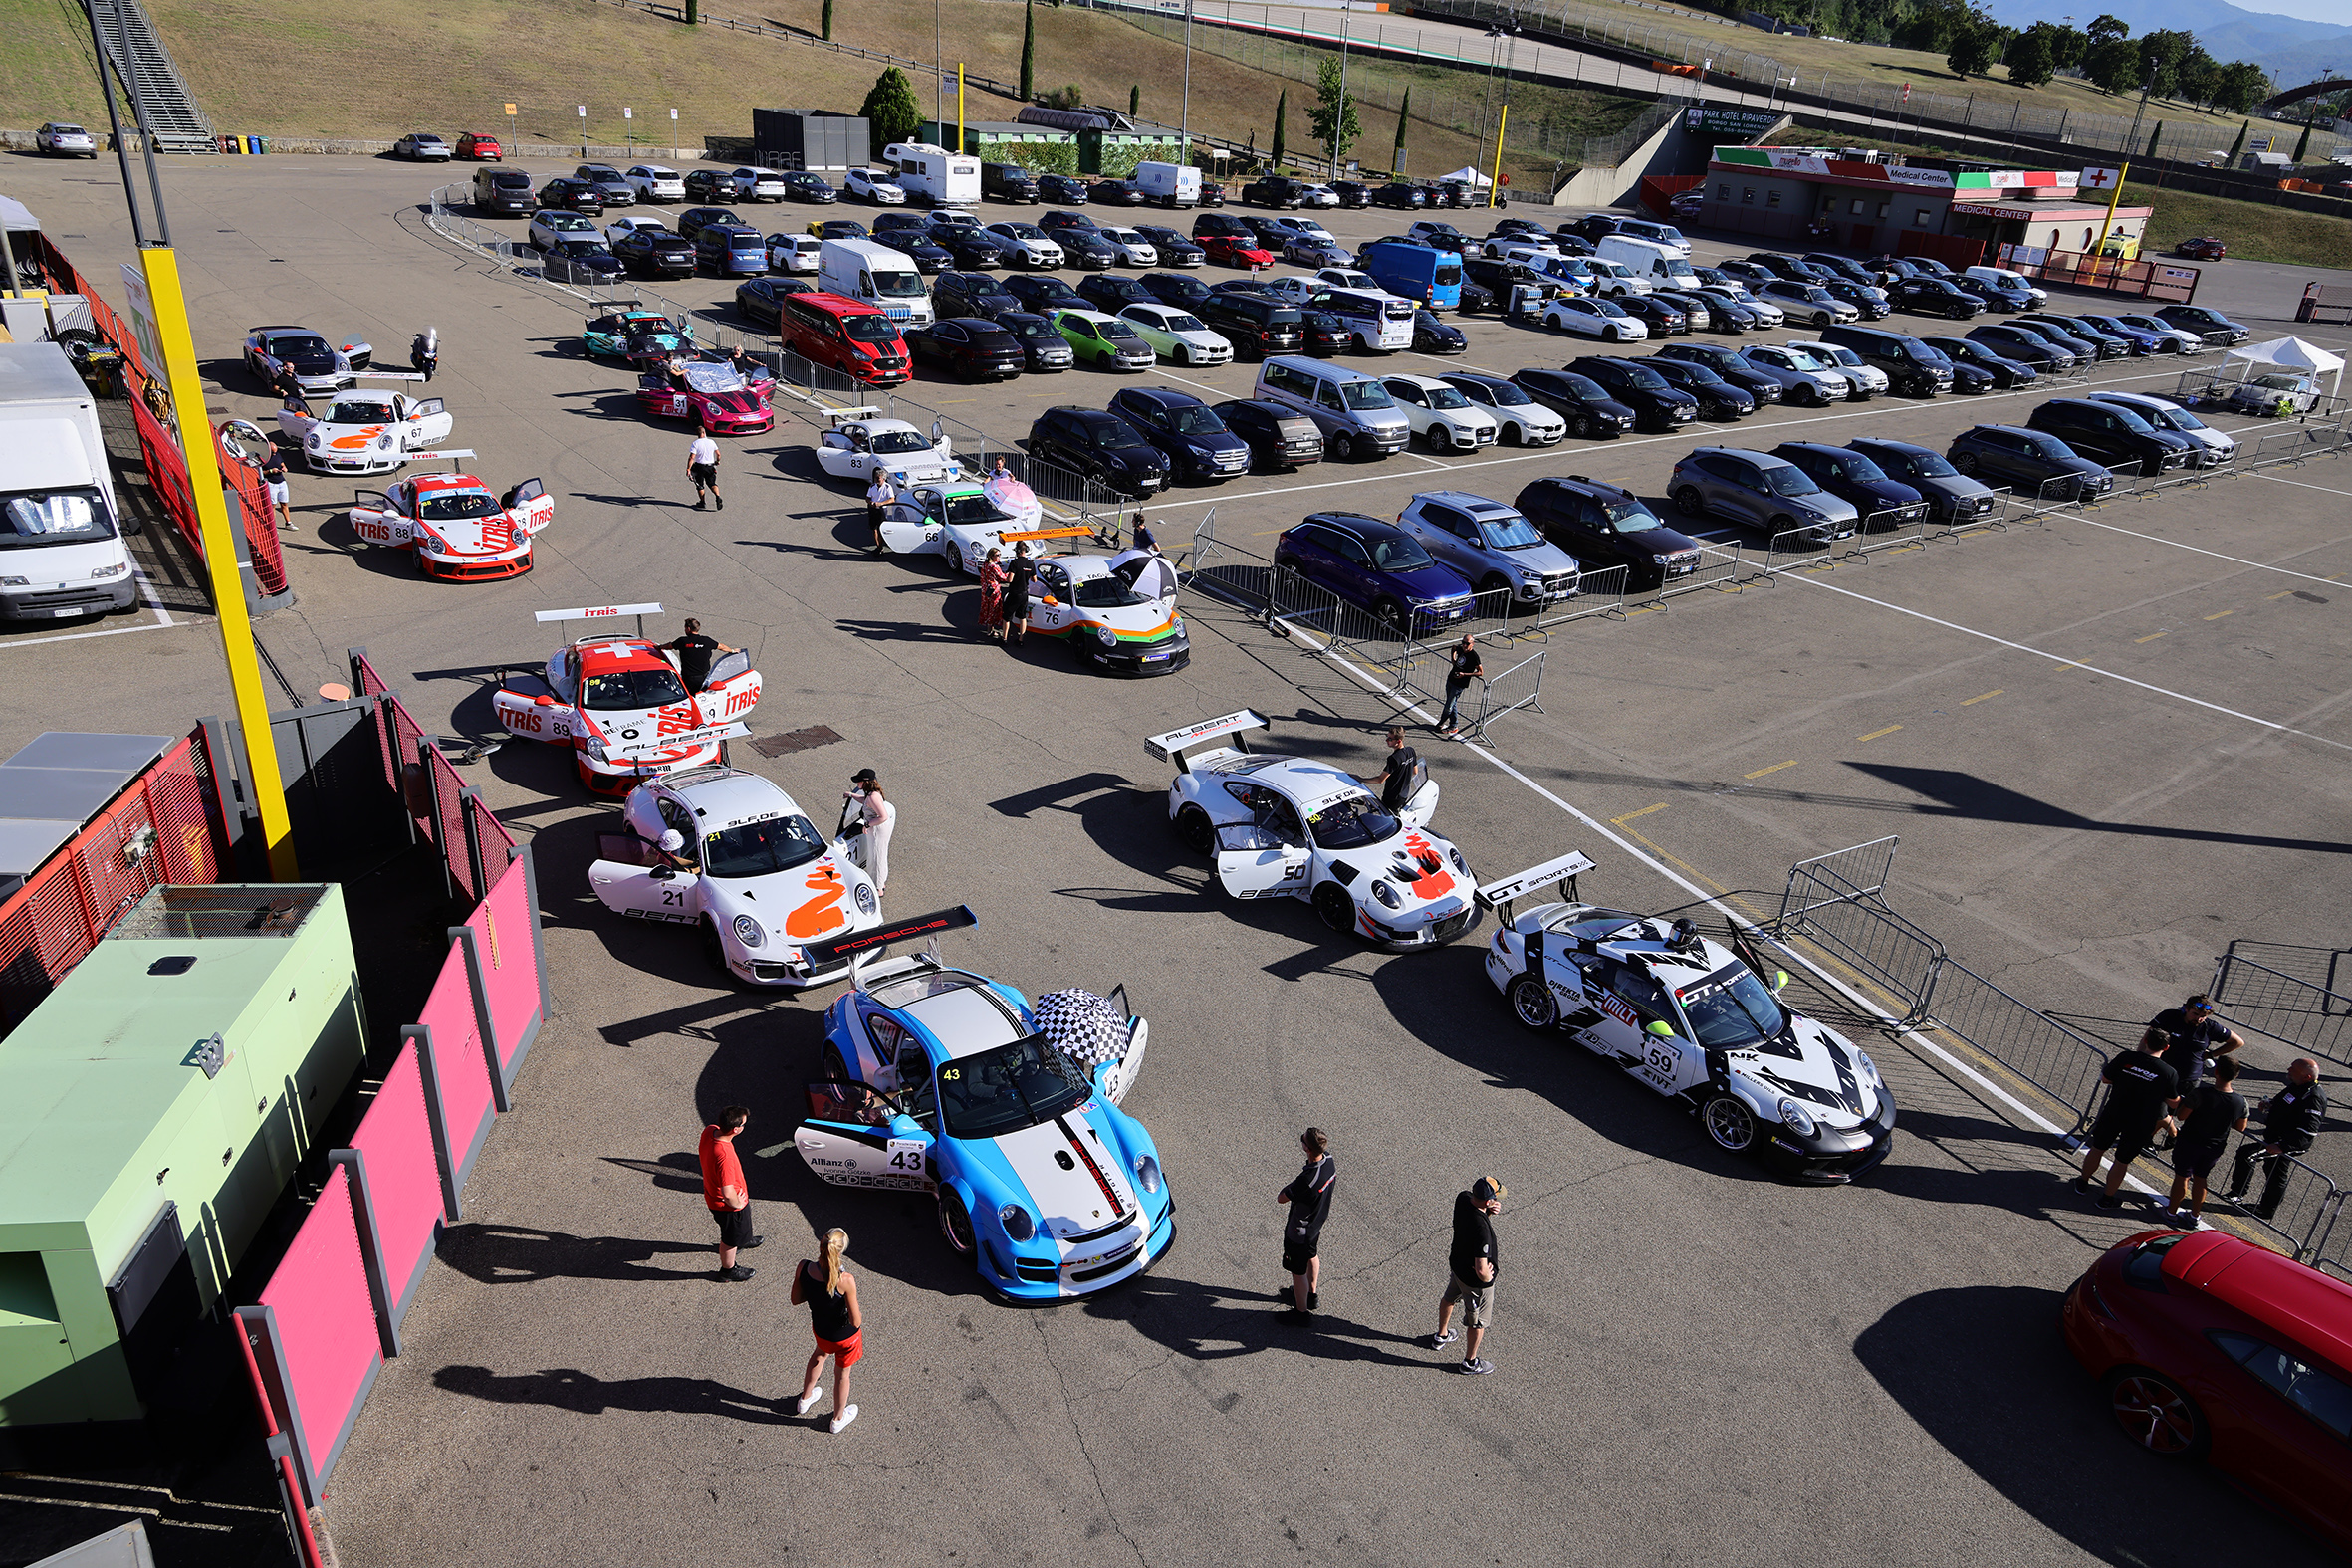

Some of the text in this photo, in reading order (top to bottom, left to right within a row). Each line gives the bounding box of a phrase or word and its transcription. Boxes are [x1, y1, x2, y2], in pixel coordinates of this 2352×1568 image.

[1703, 110, 1776, 124] PARK HOTEL RIPAVERDE
[1890, 169, 1949, 183] Medical Center
[1953, 204, 2030, 221] MEDICAL CENTER
[675, 398, 686, 408] 31
[411, 428, 422, 438] 67
[850, 459, 863, 469] 83
[430, 487, 471, 497] ROSCAR
[395, 526, 409, 540] 88
[925, 532, 939, 543] 66
[1006, 527, 1085, 539] PORSCHE
[1045, 611, 1059, 625] 76
[552, 722, 570, 737] 89
[602, 718, 647, 736] REFRAME
[1165, 715, 1240, 743] ALBERT
[1190, 719, 1243, 739] Motorsport
[622, 727, 731, 753] ALBERT
[651, 731, 730, 752] Motorsport
[1308, 813, 1321, 825] 50
[707, 831, 722, 842] 21
[1283, 865, 1306, 882] 50
[1487, 863, 1579, 902] GT SPORTS
[662, 890, 684, 907] 21
[833, 919, 949, 954] PORSCHE
[1548, 979, 1581, 999] DIREKTA
[1683, 983, 1713, 1005] GT
[1558, 991, 1580, 1003] GROUP
[1604, 995, 1638, 1024] MILT
[1584, 1031, 1598, 1043] FD
[1648, 1048, 1673, 1073] 59
[1730, 1051, 1760, 1062] NK
[943, 1068, 961, 1081] 43
[1741, 1071, 1775, 1095] MILLERS OILS
[811, 1157, 843, 1167] Allianz
[890, 1151, 922, 1171] 43
[1070, 1139, 1122, 1215] PORSCHE
[1103, 1172, 1116, 1189] GT3
[1114, 1189, 1126, 1204] 911
[1106, 1243, 1132, 1258] MICHELIN
